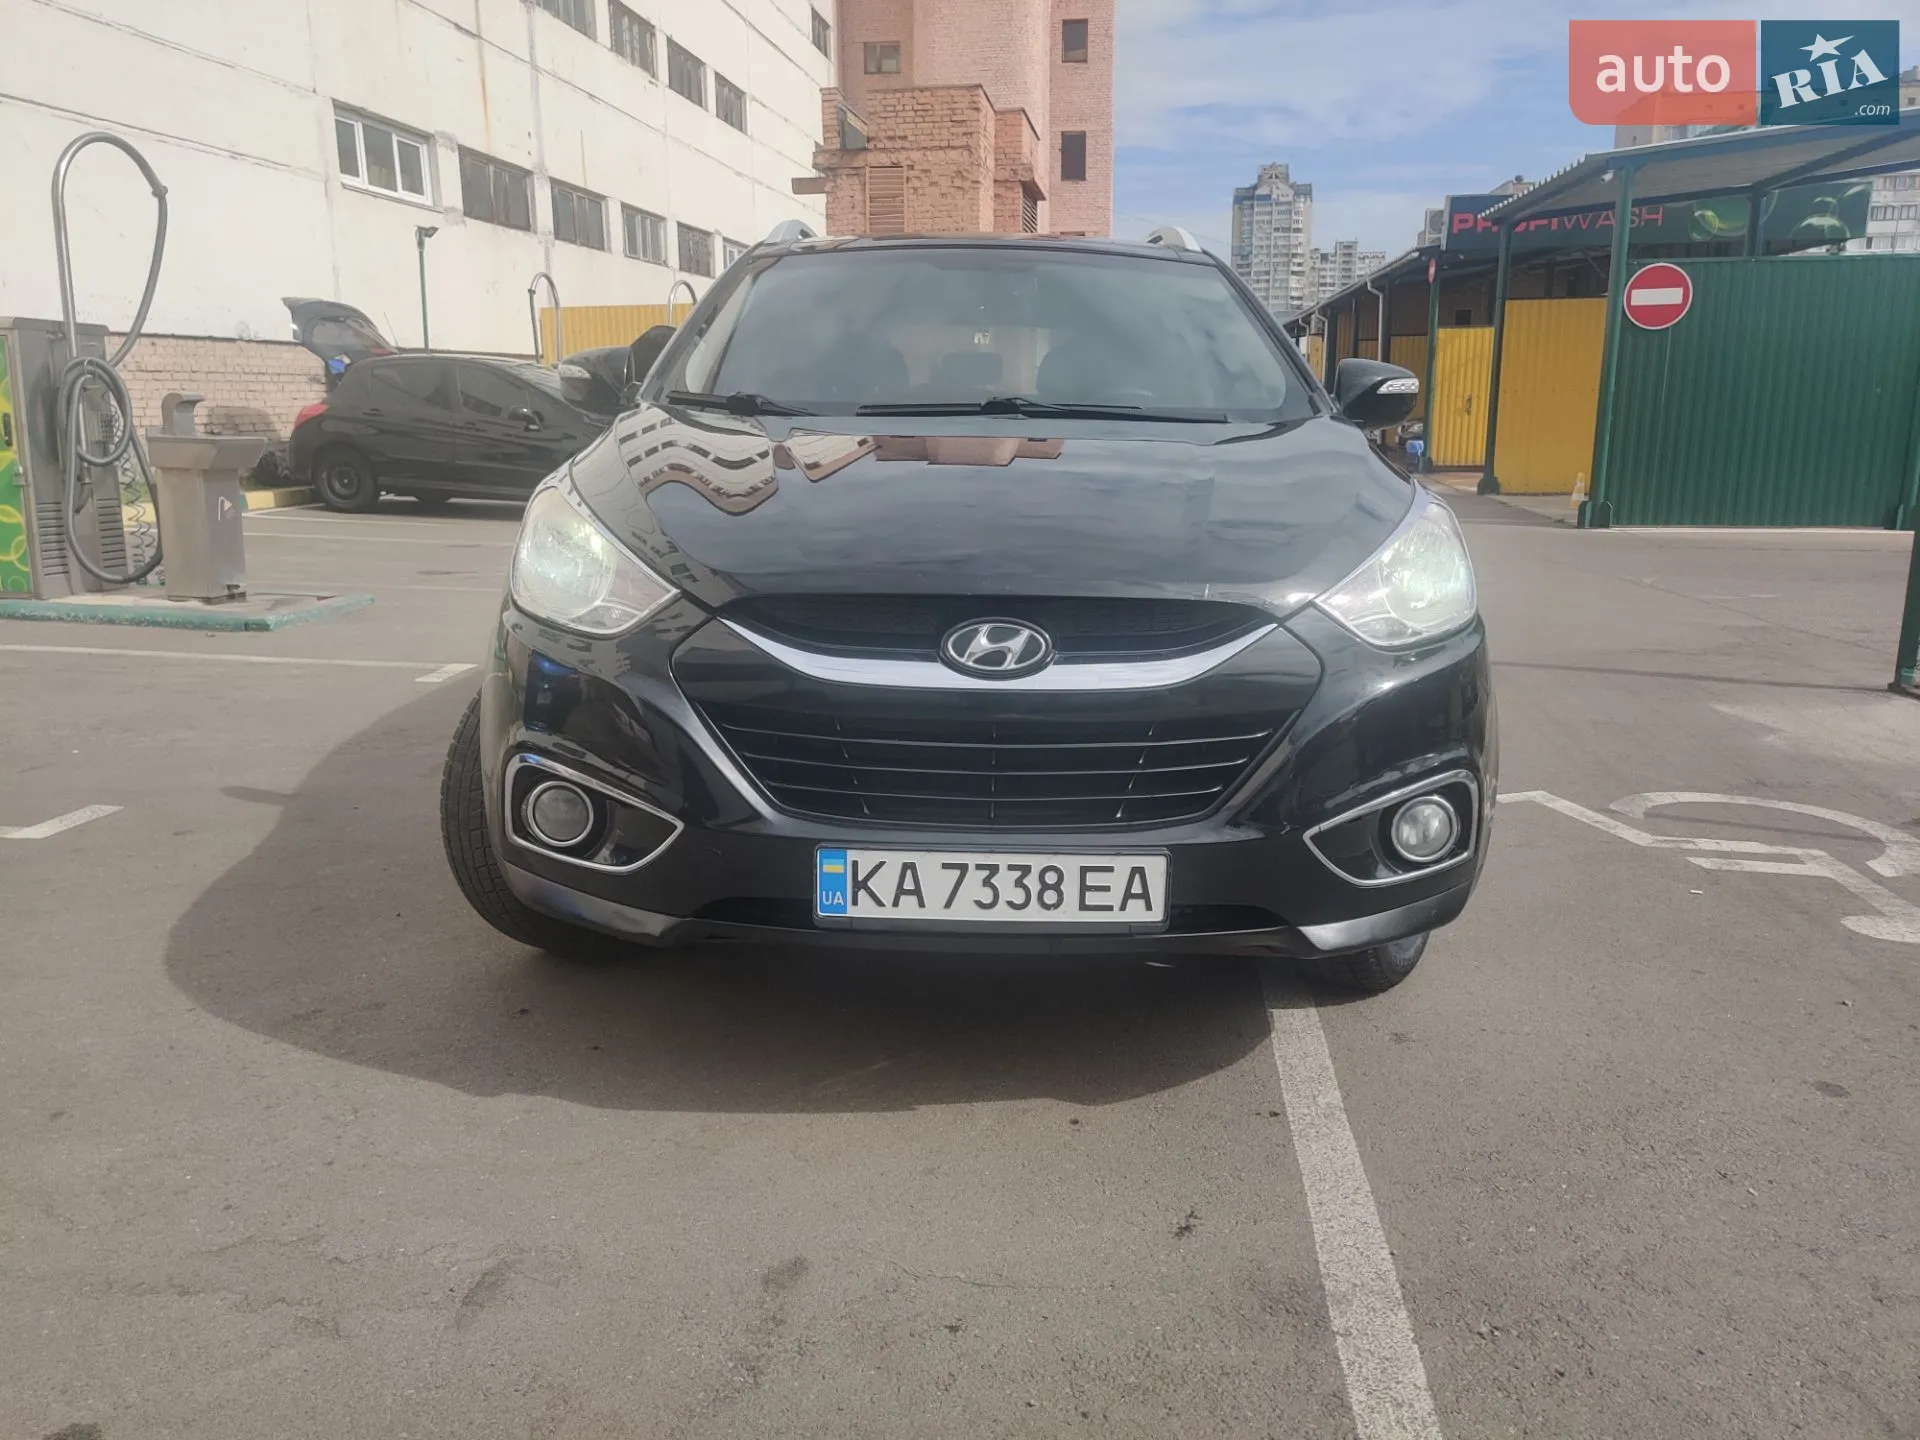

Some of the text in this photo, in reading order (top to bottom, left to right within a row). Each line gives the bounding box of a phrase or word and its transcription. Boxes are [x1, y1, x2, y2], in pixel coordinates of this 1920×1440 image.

[822, 890, 846, 906] UA
[850, 859, 1154, 912] KA 7338 EA
